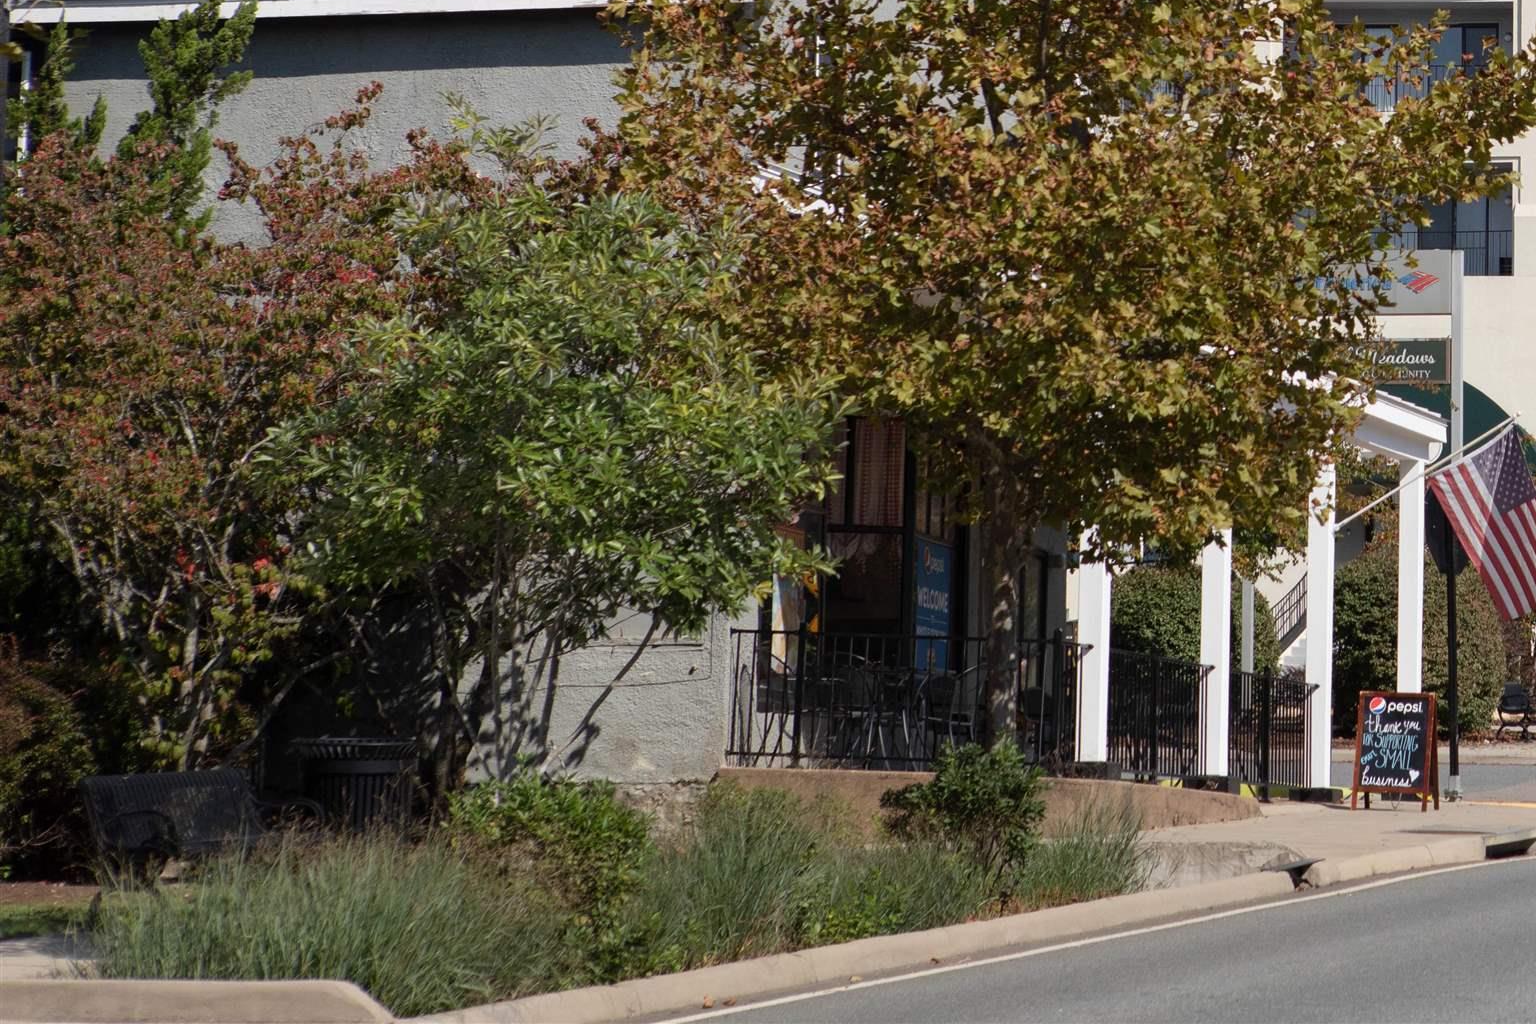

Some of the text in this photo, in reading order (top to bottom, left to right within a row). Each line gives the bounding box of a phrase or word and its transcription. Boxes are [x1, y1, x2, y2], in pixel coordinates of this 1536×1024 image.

[916, 585, 949, 613] WELCOME
[1387, 701, 1422, 715] pepsi
[1364, 714, 1421, 735] thank you
[1375, 748, 1412, 770] SMALL
[1361, 765, 1412, 788] business
